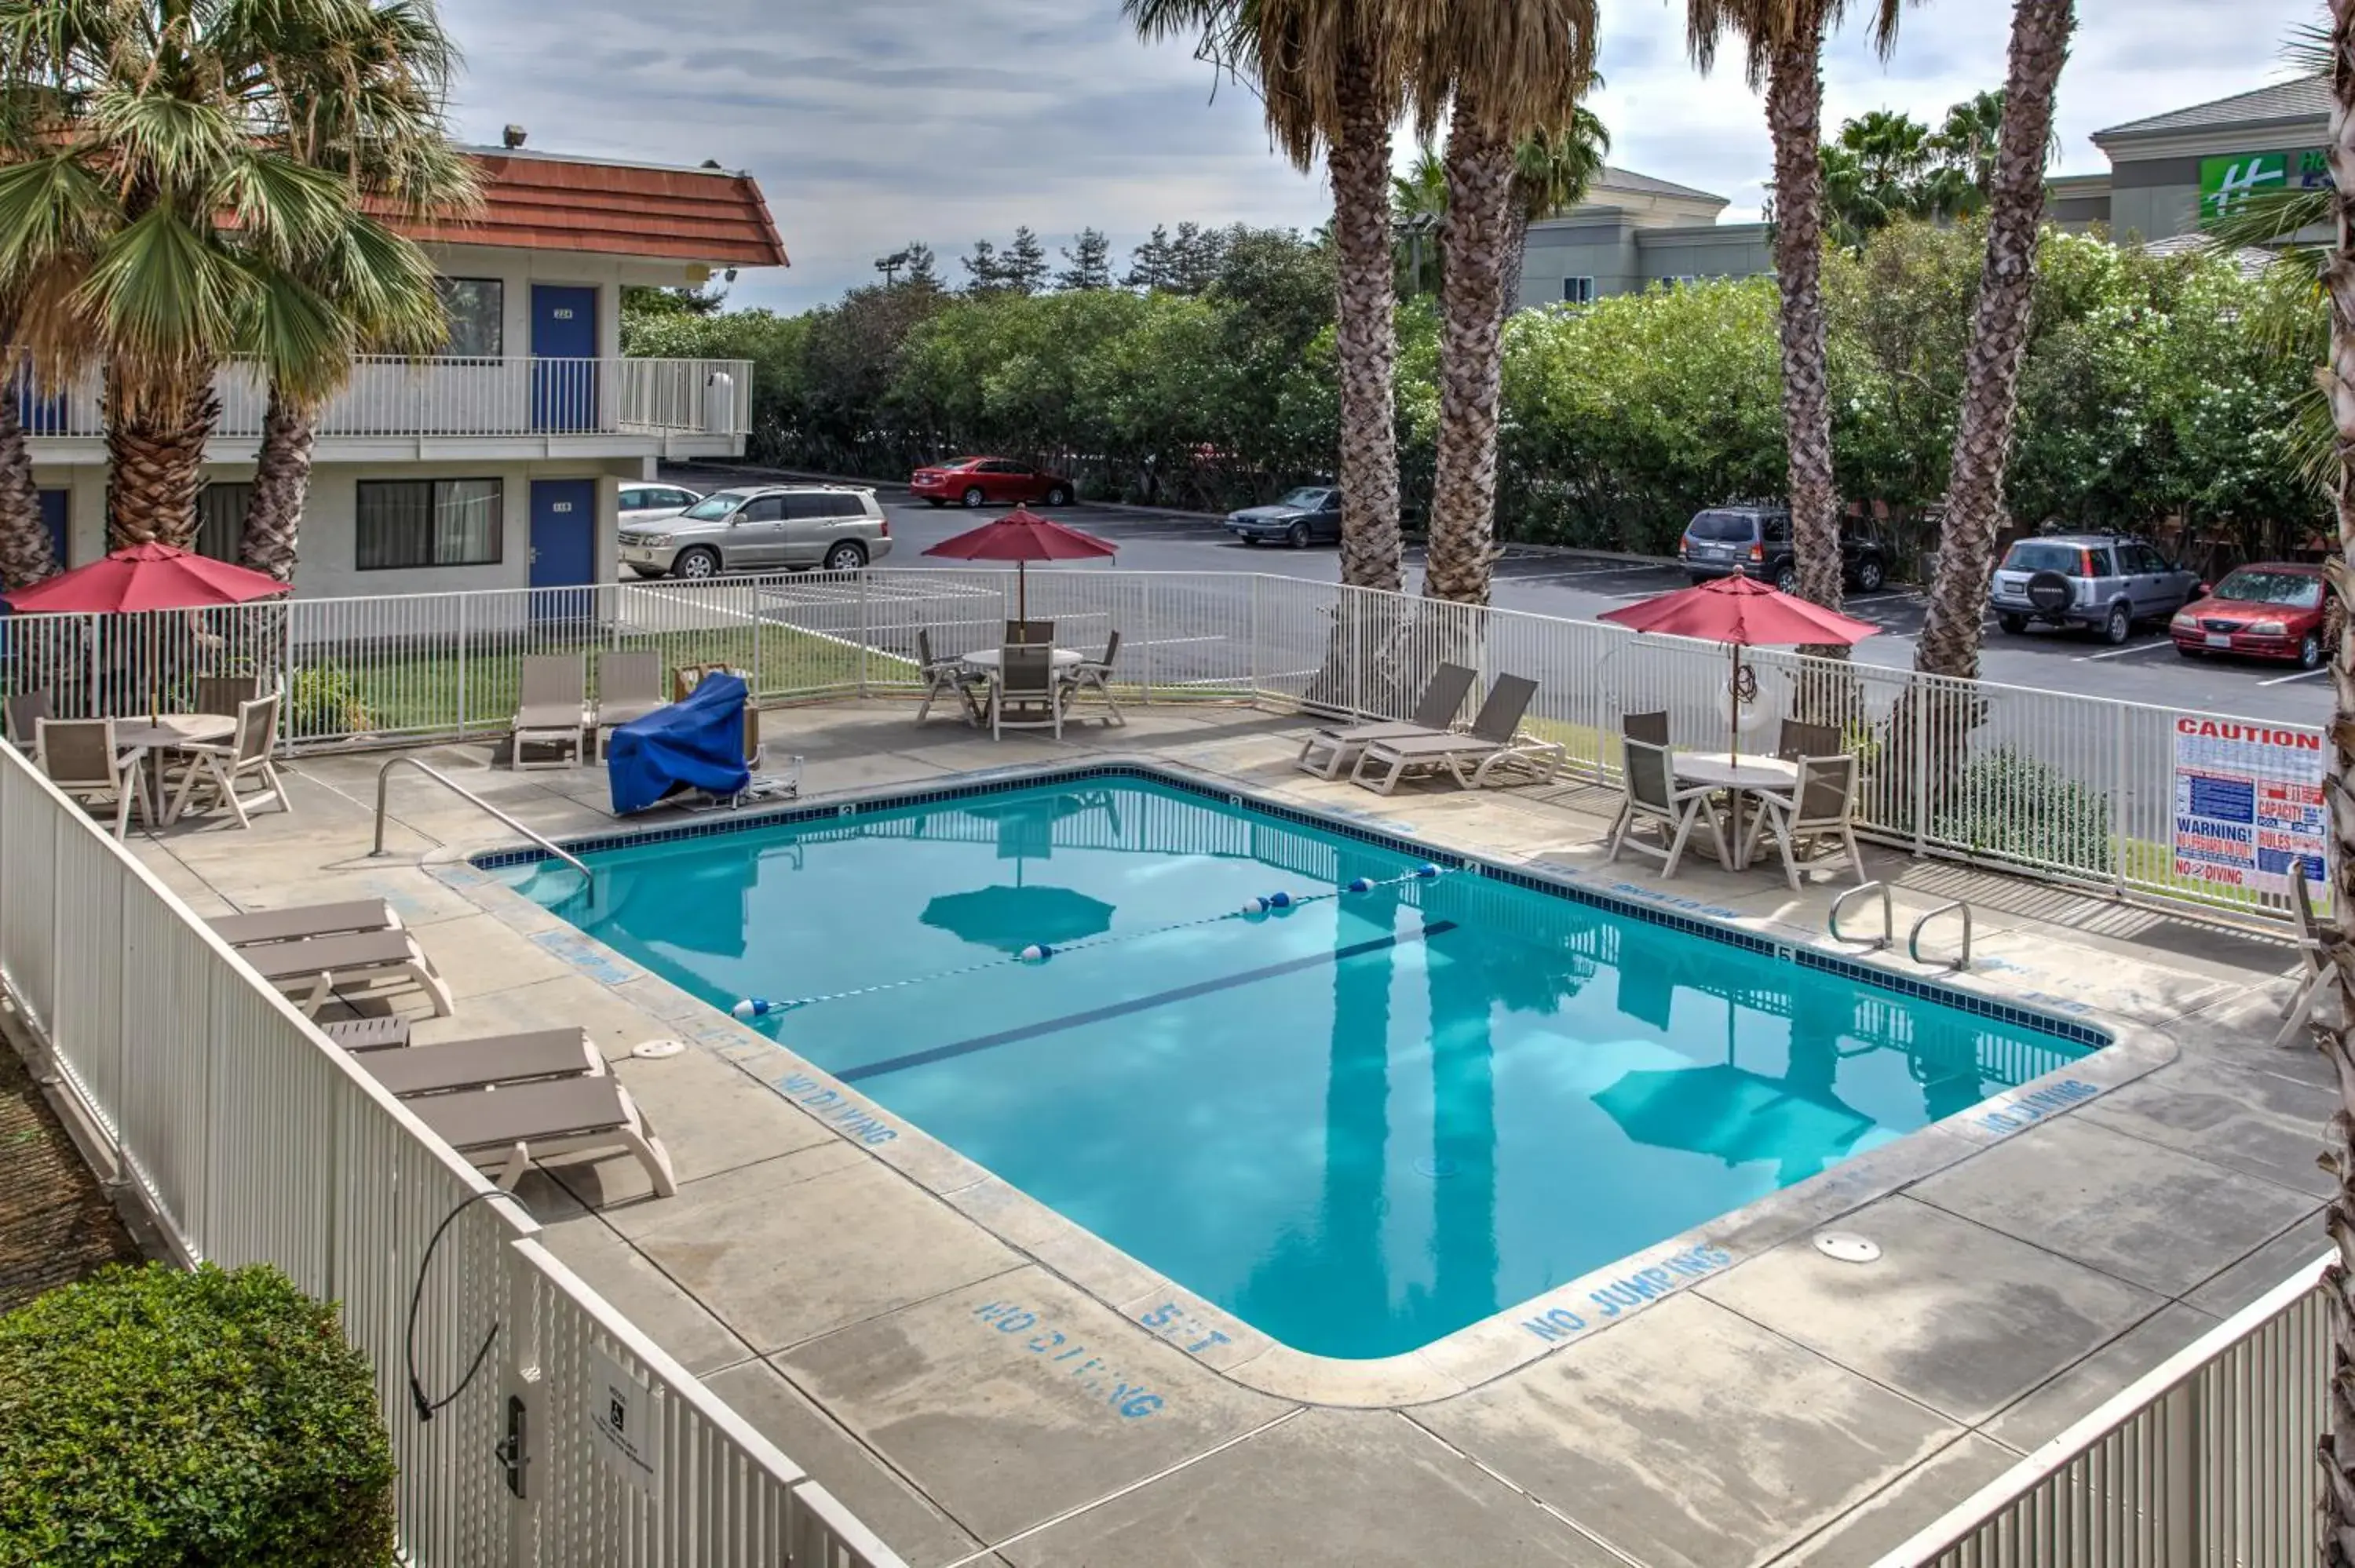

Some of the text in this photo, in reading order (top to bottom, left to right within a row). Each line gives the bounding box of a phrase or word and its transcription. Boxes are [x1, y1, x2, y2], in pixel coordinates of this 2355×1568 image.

[2178, 718, 2320, 751] CAUTION
[2177, 817, 2252, 843] WARNING!
[2258, 830, 2291, 851] RULES
[2176, 859, 2190, 875] NO
[2205, 864, 2243, 884] DIVING
[1779, 946, 1791, 961] 5
[1521, 1243, 1731, 1342] NO JUMPING
